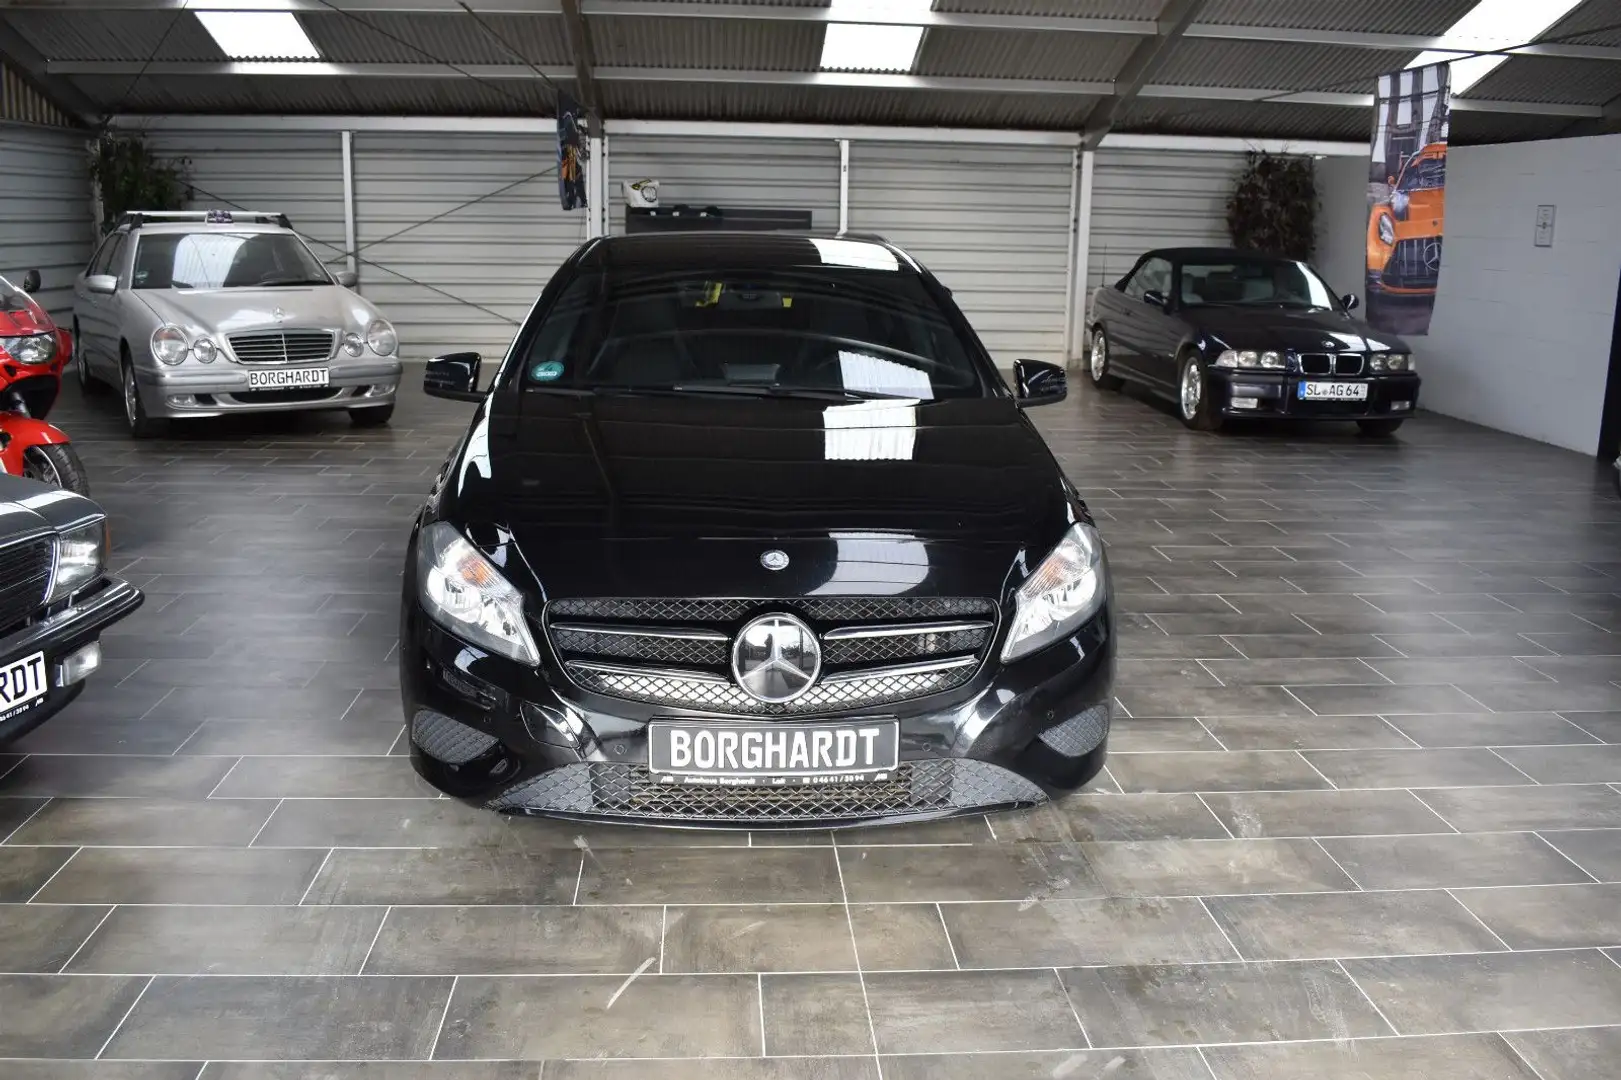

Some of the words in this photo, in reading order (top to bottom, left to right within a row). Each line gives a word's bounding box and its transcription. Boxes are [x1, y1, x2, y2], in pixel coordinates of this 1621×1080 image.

[250, 370, 327, 385] BORGHARDT
[1306, 384, 1321, 396] SL
[1329, 385, 1344, 396] AG
[1346, 385, 1359, 396] 64
[670, 728, 880, 769] BORGHARDT
